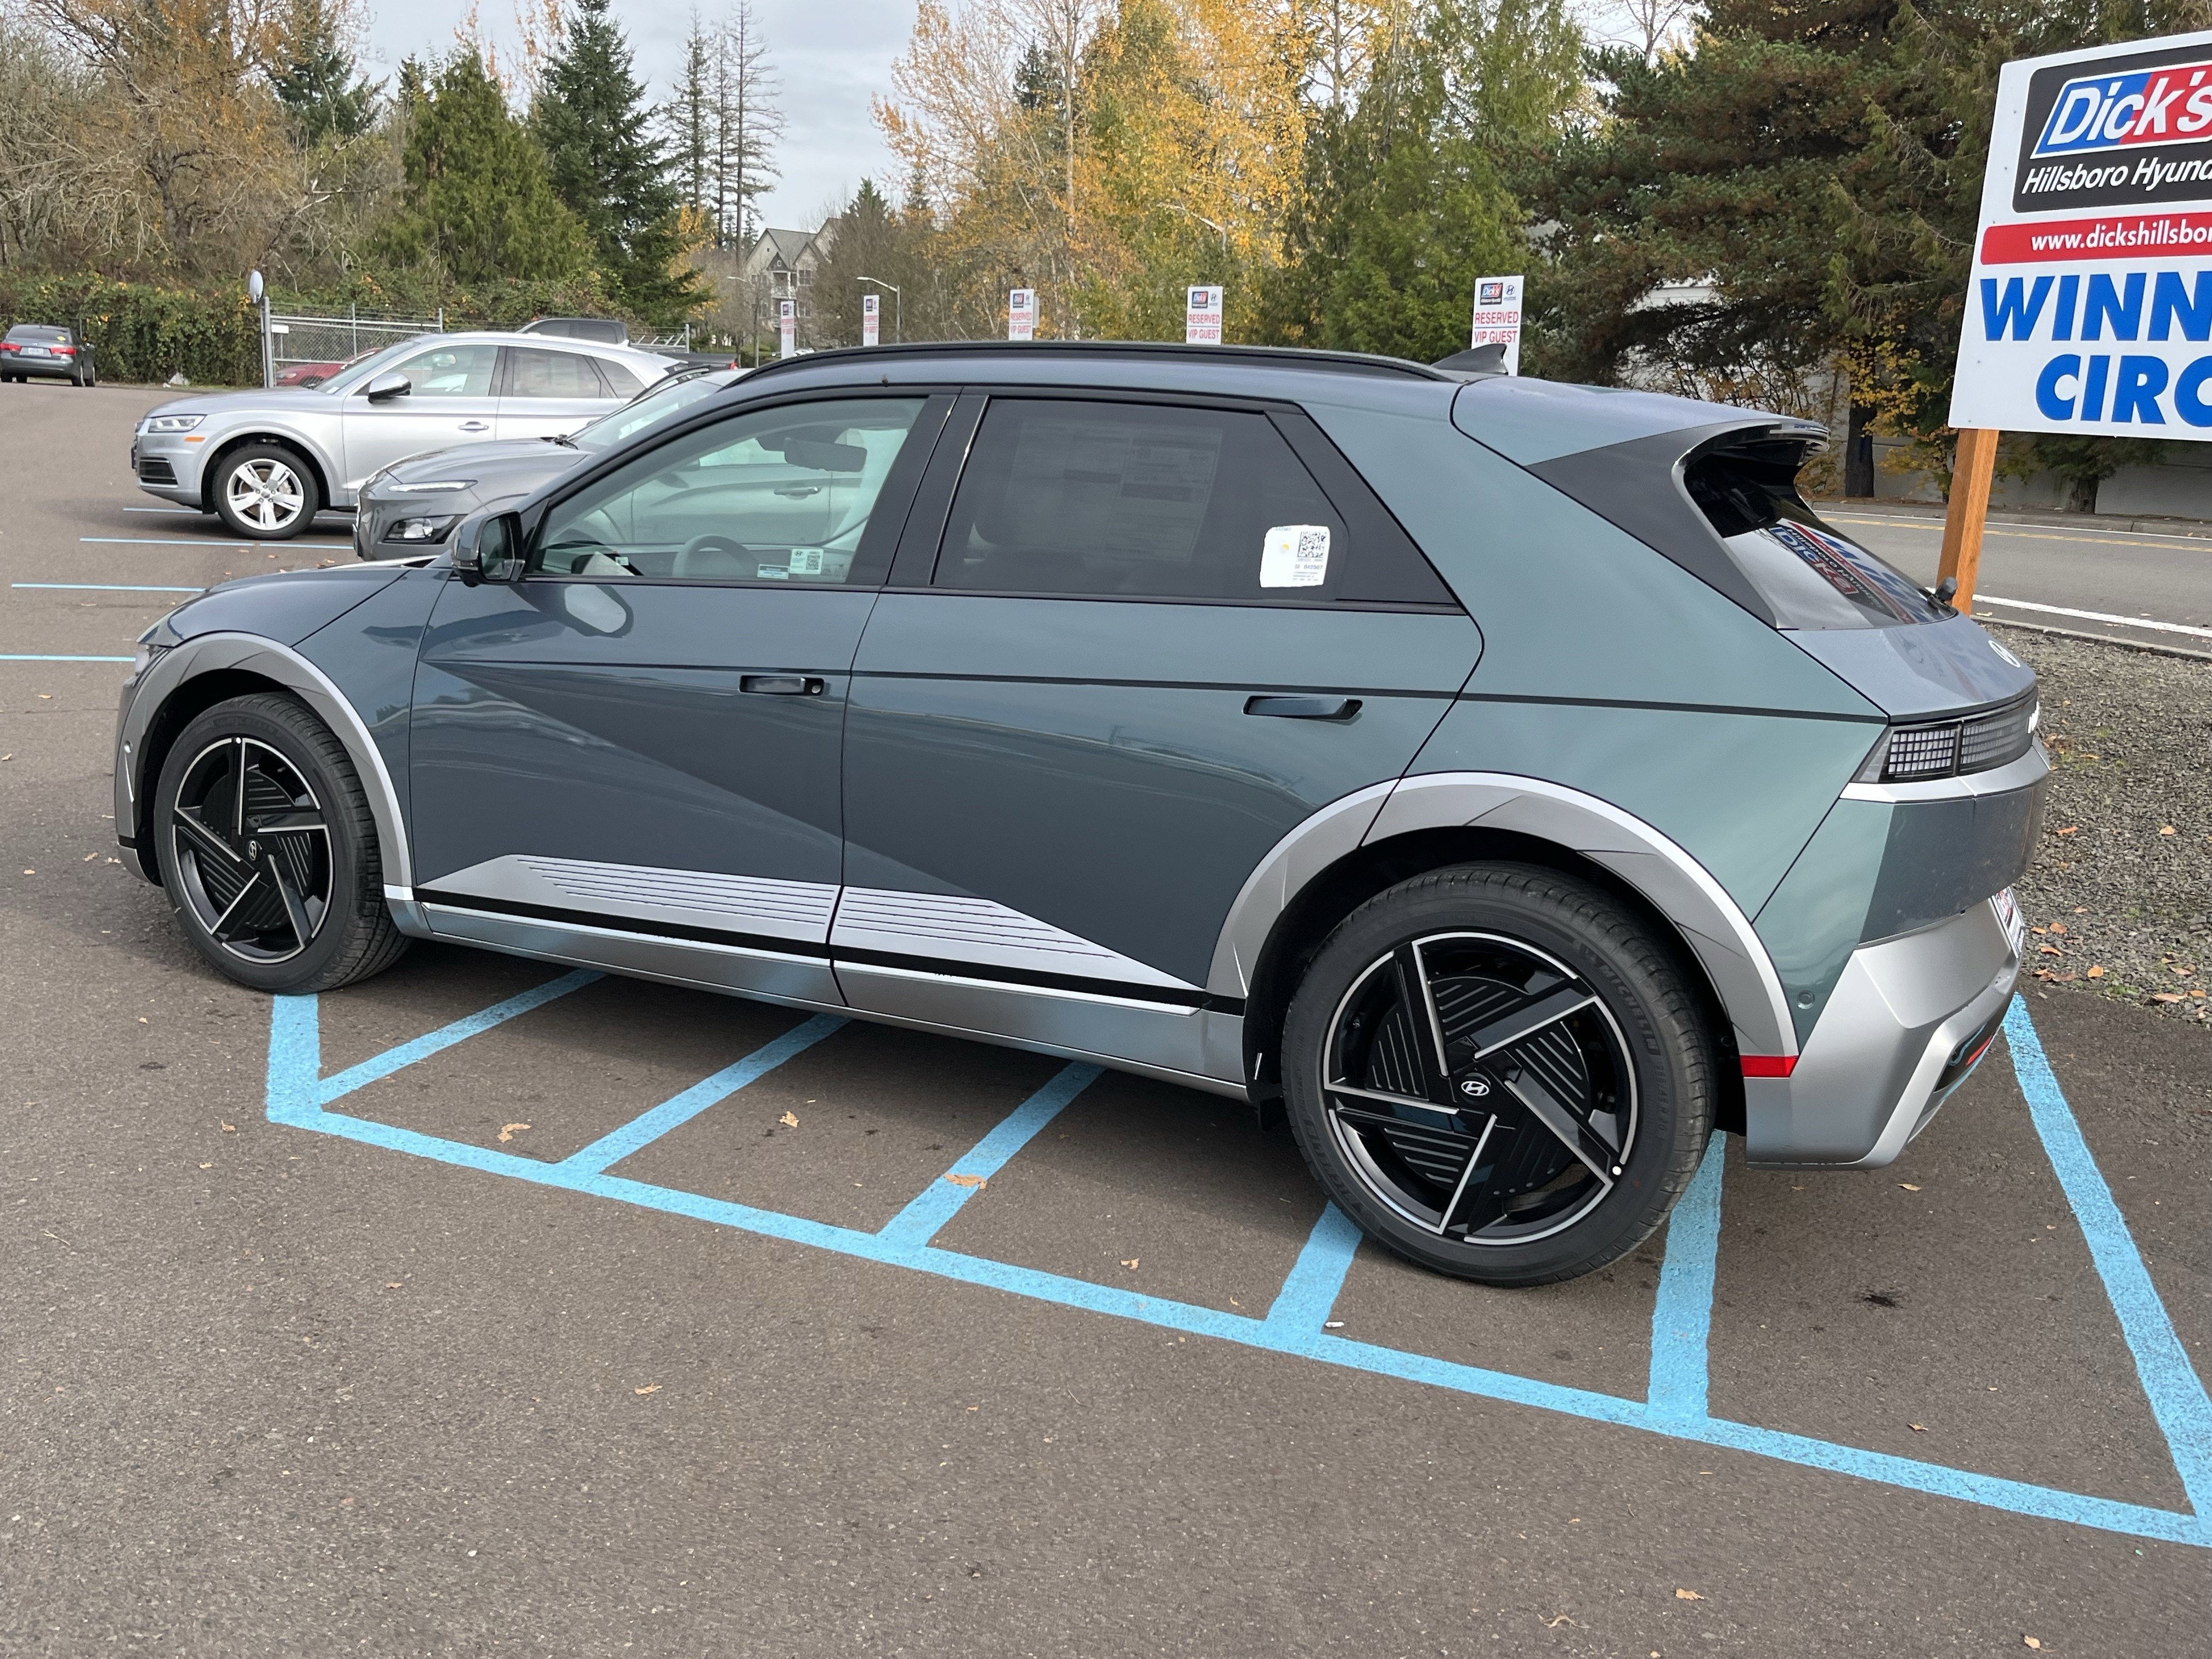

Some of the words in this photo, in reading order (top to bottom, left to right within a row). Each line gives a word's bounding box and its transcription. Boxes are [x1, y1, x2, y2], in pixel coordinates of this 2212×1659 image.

[2047, 70, 2212, 145] Dick's
[2022, 163, 2129, 194] Hillsboro
[1188, 314, 1220, 324] RESERVED
[1475, 311, 1519, 324] RESERVED
[1980, 271, 2212, 341] WINN
[1188, 329, 1198, 339] VIP
[1199, 329, 1220, 340] GUEST
[1475, 331, 1487, 343] VIP
[1489, 330, 1517, 343] GUEST
[2036, 354, 2212, 427] CIRC
[1598, 964, 1660, 1051] MICHELIN
